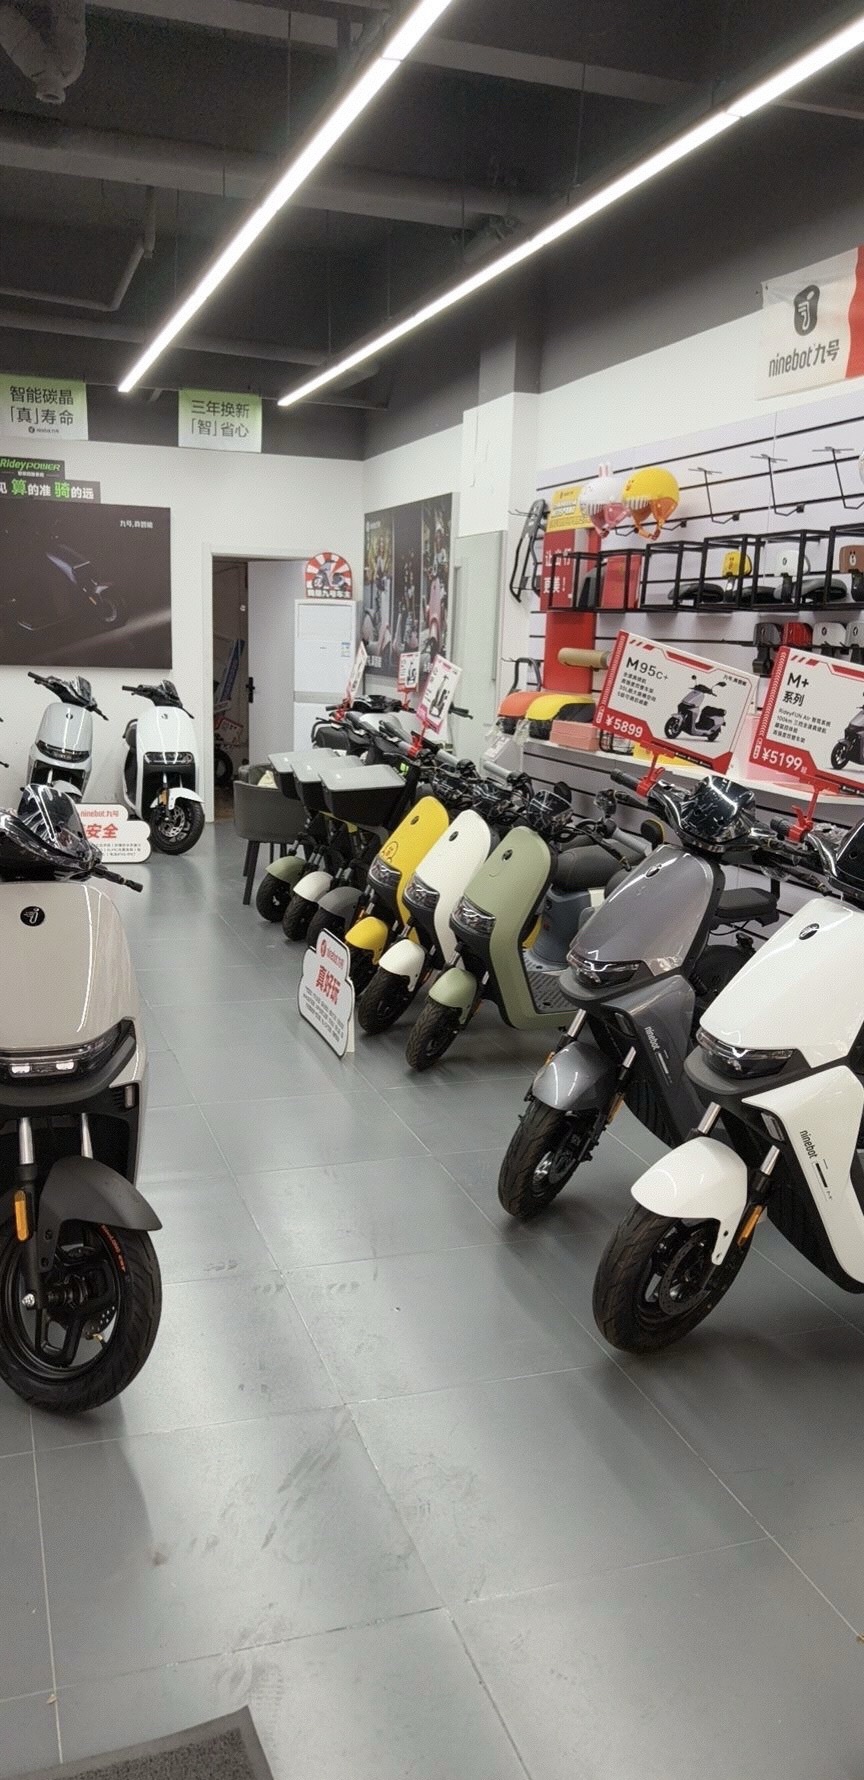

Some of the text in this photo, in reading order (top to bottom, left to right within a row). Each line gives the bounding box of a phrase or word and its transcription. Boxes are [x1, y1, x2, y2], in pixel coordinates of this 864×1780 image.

[768, 339, 840, 377] ninebot 九号
[10, 385, 74, 405] 智能碳晶
[191, 400, 250, 419] 三年换新
[787, 673, 809, 688] M+
[782, 691, 805, 707] 系列
[605, 715, 643, 738] ¥5899
[84, 823, 118, 839] 安全
[644, 1026, 661, 1051] ninebot
[799, 1130, 817, 1159] ninebot
